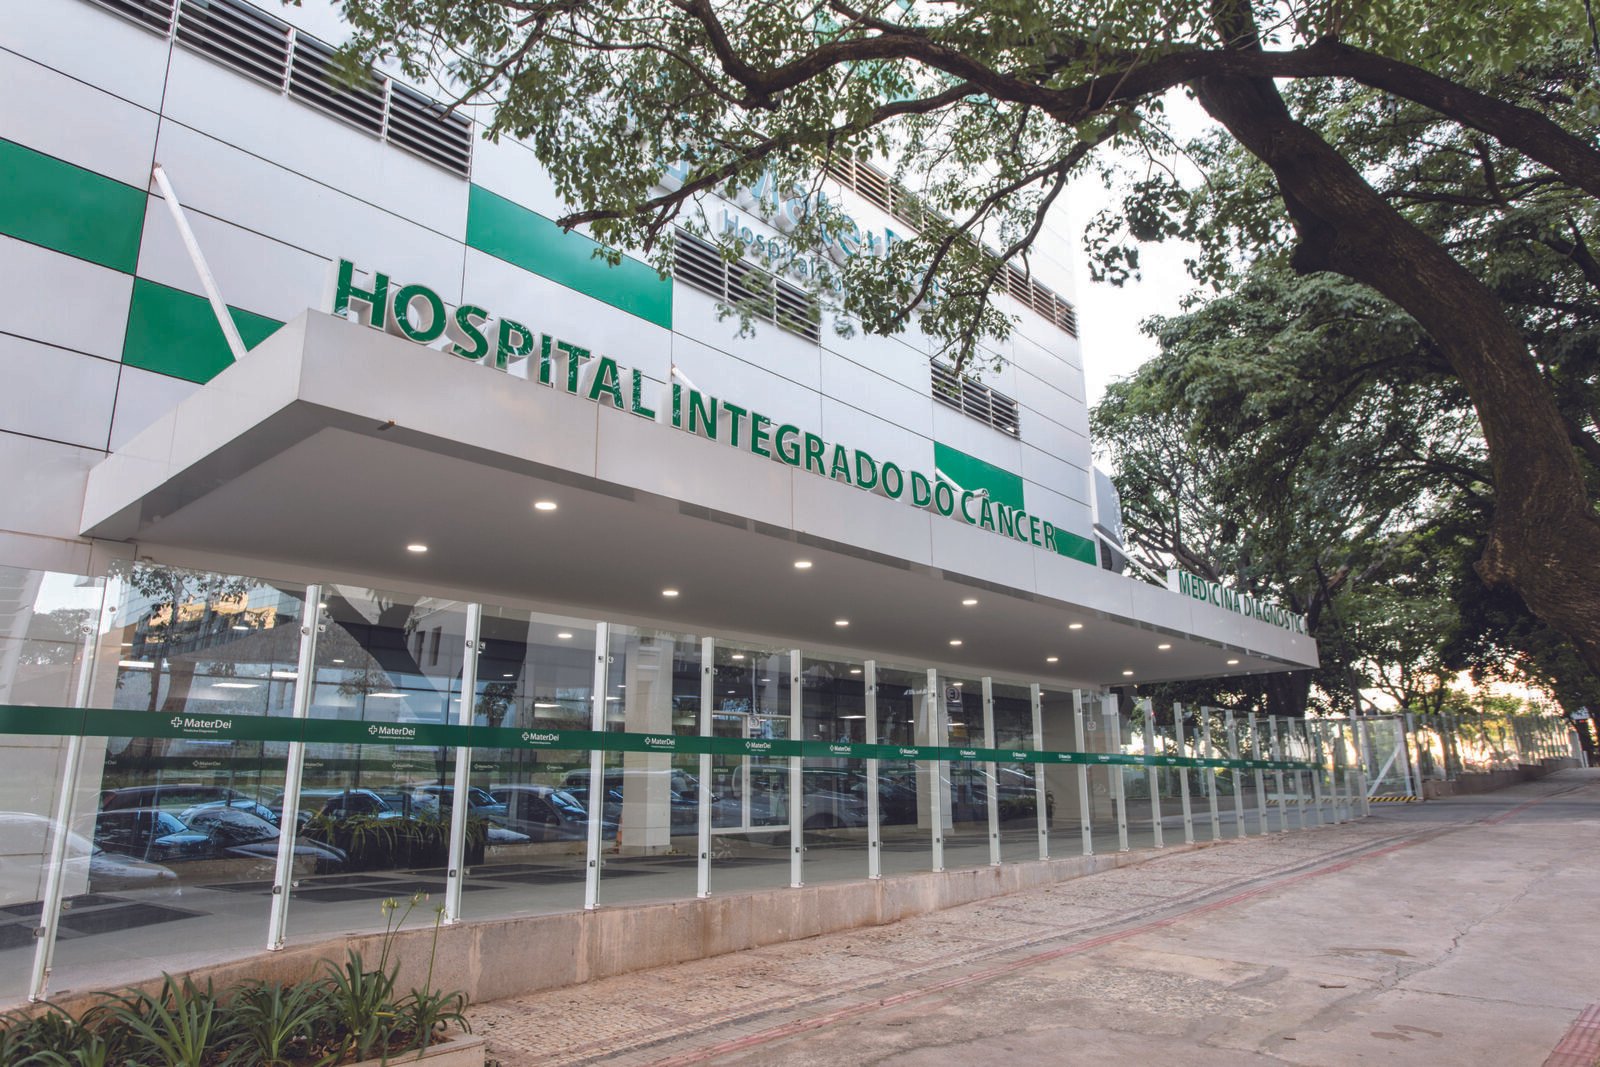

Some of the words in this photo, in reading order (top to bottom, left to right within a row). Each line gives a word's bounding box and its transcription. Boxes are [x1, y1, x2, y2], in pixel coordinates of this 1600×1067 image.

[331, 257, 657, 420] HOSPITAL
[672, 383, 904, 500] INTEGRADO
[911, 470, 955, 517] DO
[961, 488, 1058, 553] CÂNCER
[1178, 570, 1242, 615] MEDICINA
[184, 718, 232, 729] MaterDei
[378, 726, 416, 736] MaterDei
[529, 732, 560, 741] MaterDei
[651, 737, 676, 746] MaterDei
